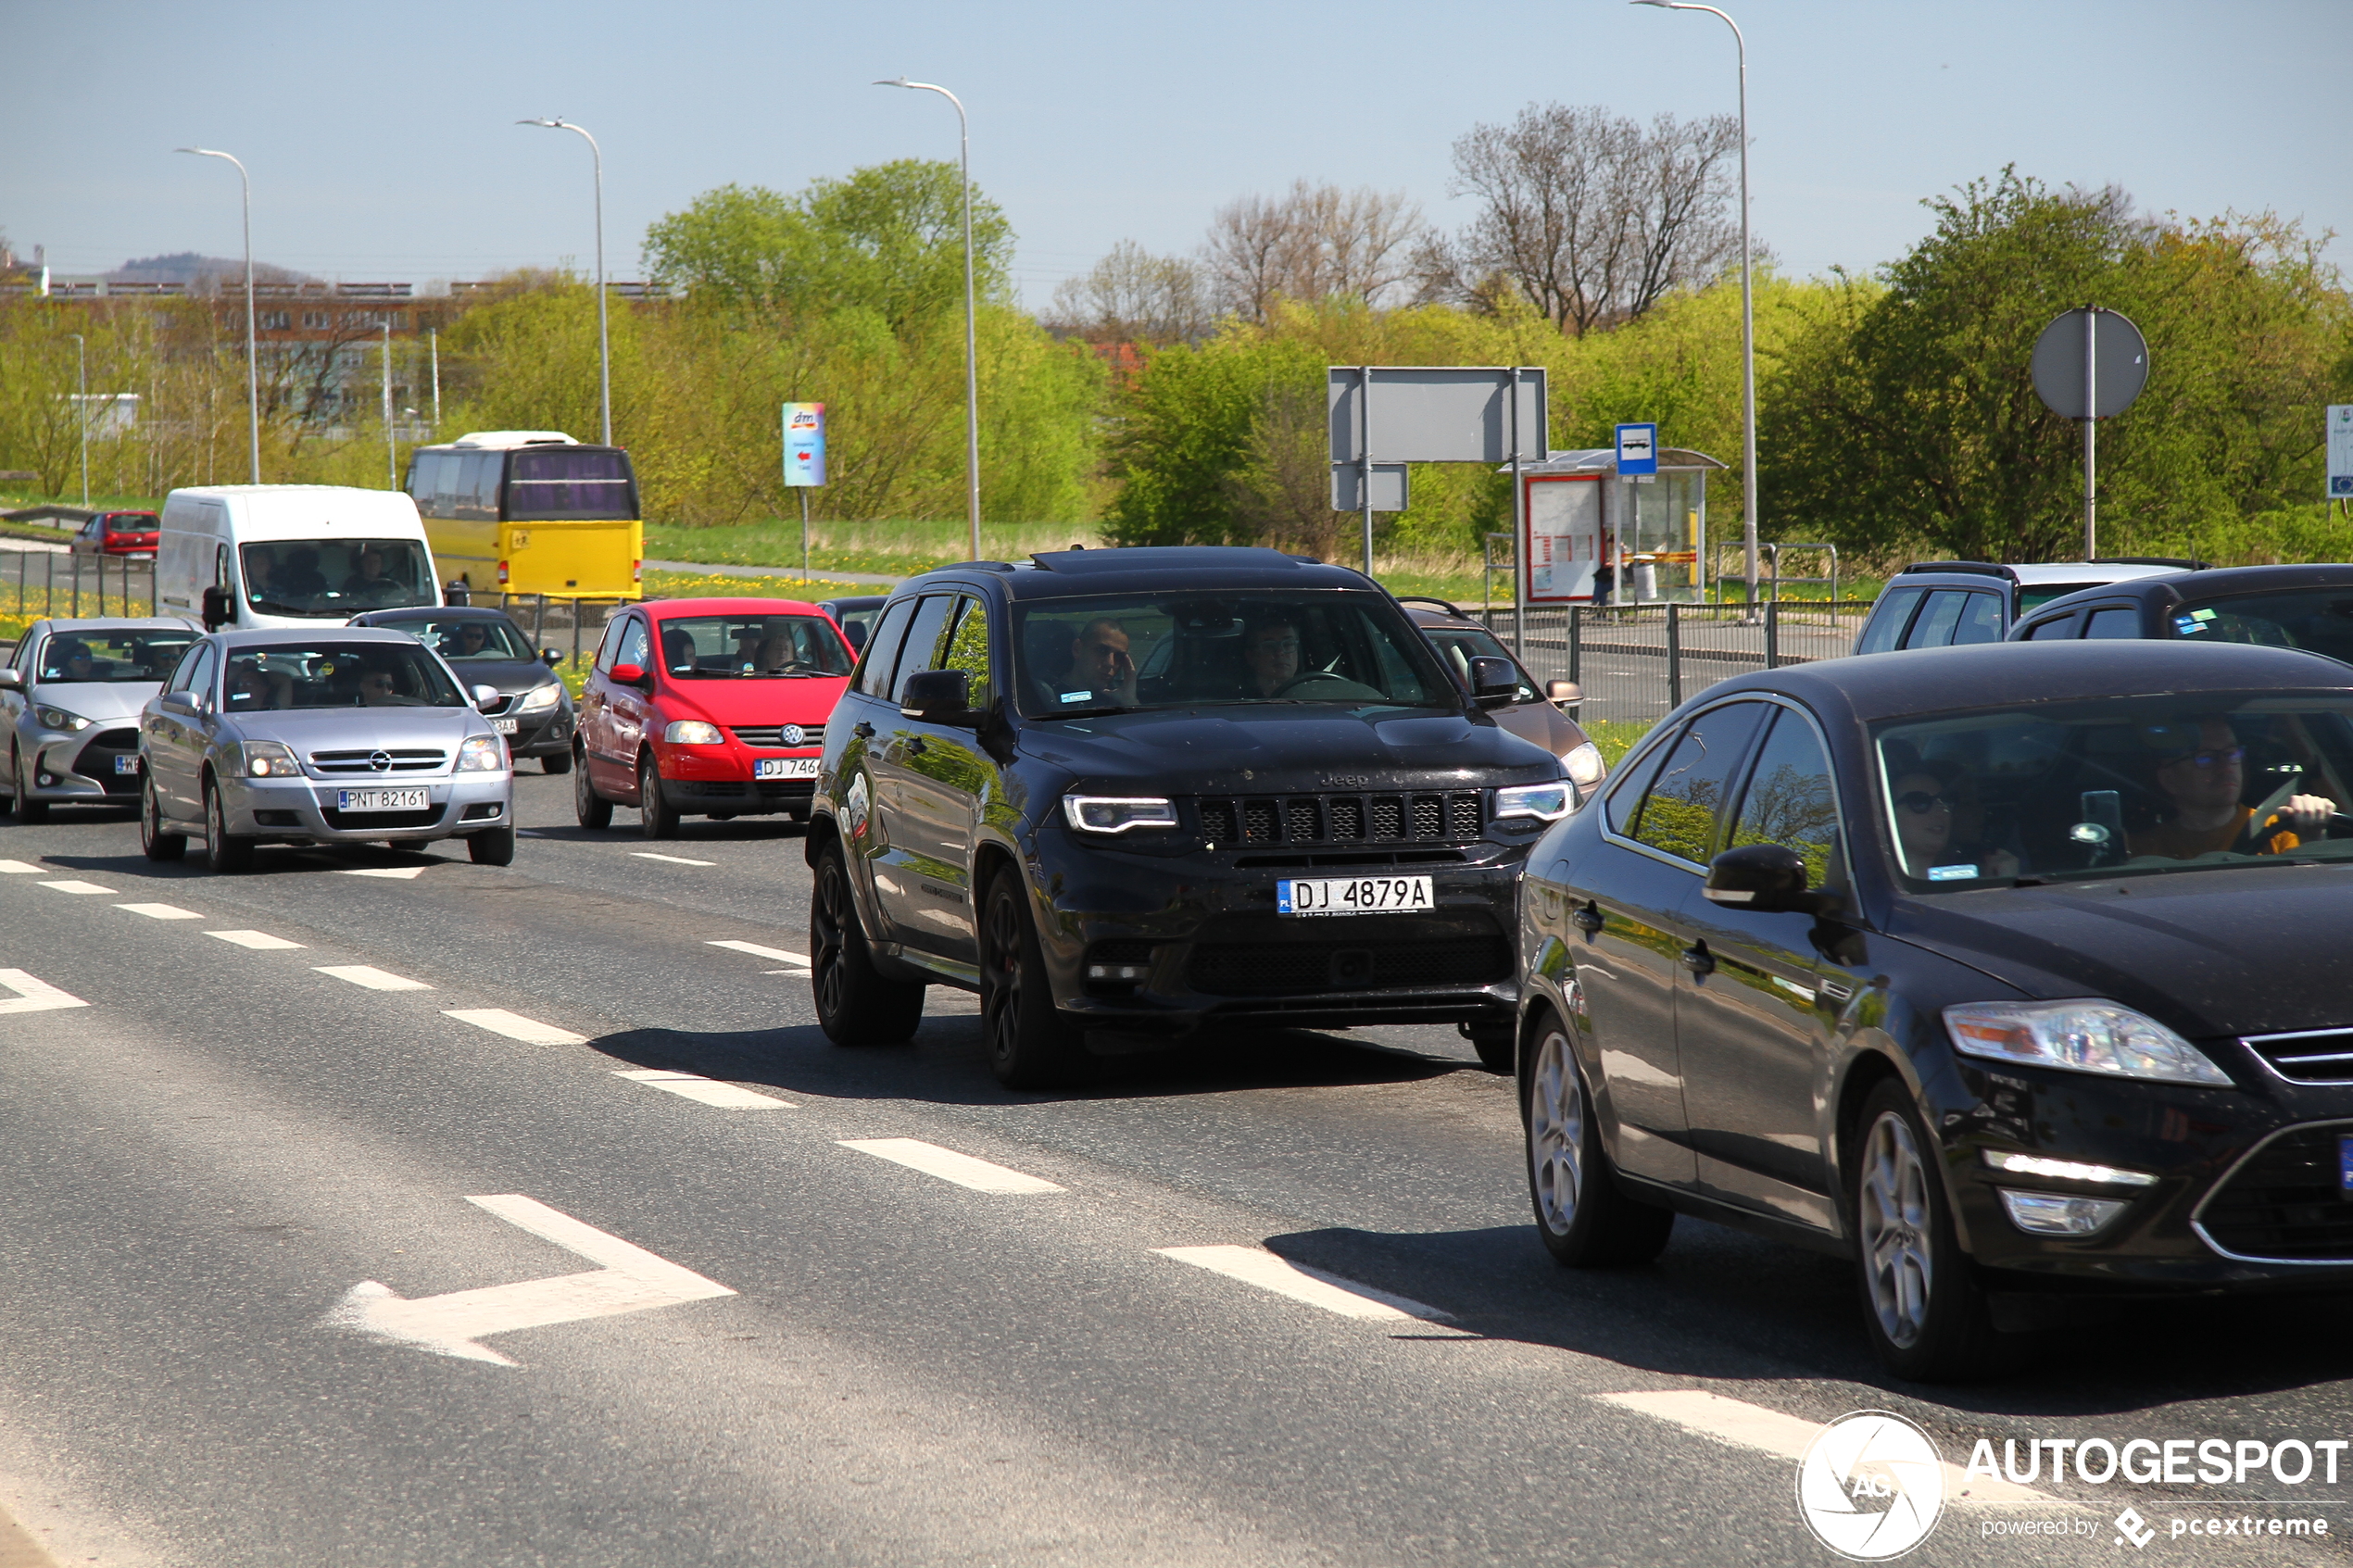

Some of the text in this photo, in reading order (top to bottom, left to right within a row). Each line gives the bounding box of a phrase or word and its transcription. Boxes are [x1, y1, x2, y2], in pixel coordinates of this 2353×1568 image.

[794, 411, 813, 423] dm
[764, 760, 783, 775] DJ
[1319, 772, 1368, 789] Jeep
[348, 791, 424, 808] PNT 82161
[1297, 879, 1427, 909] DJ 4879A
